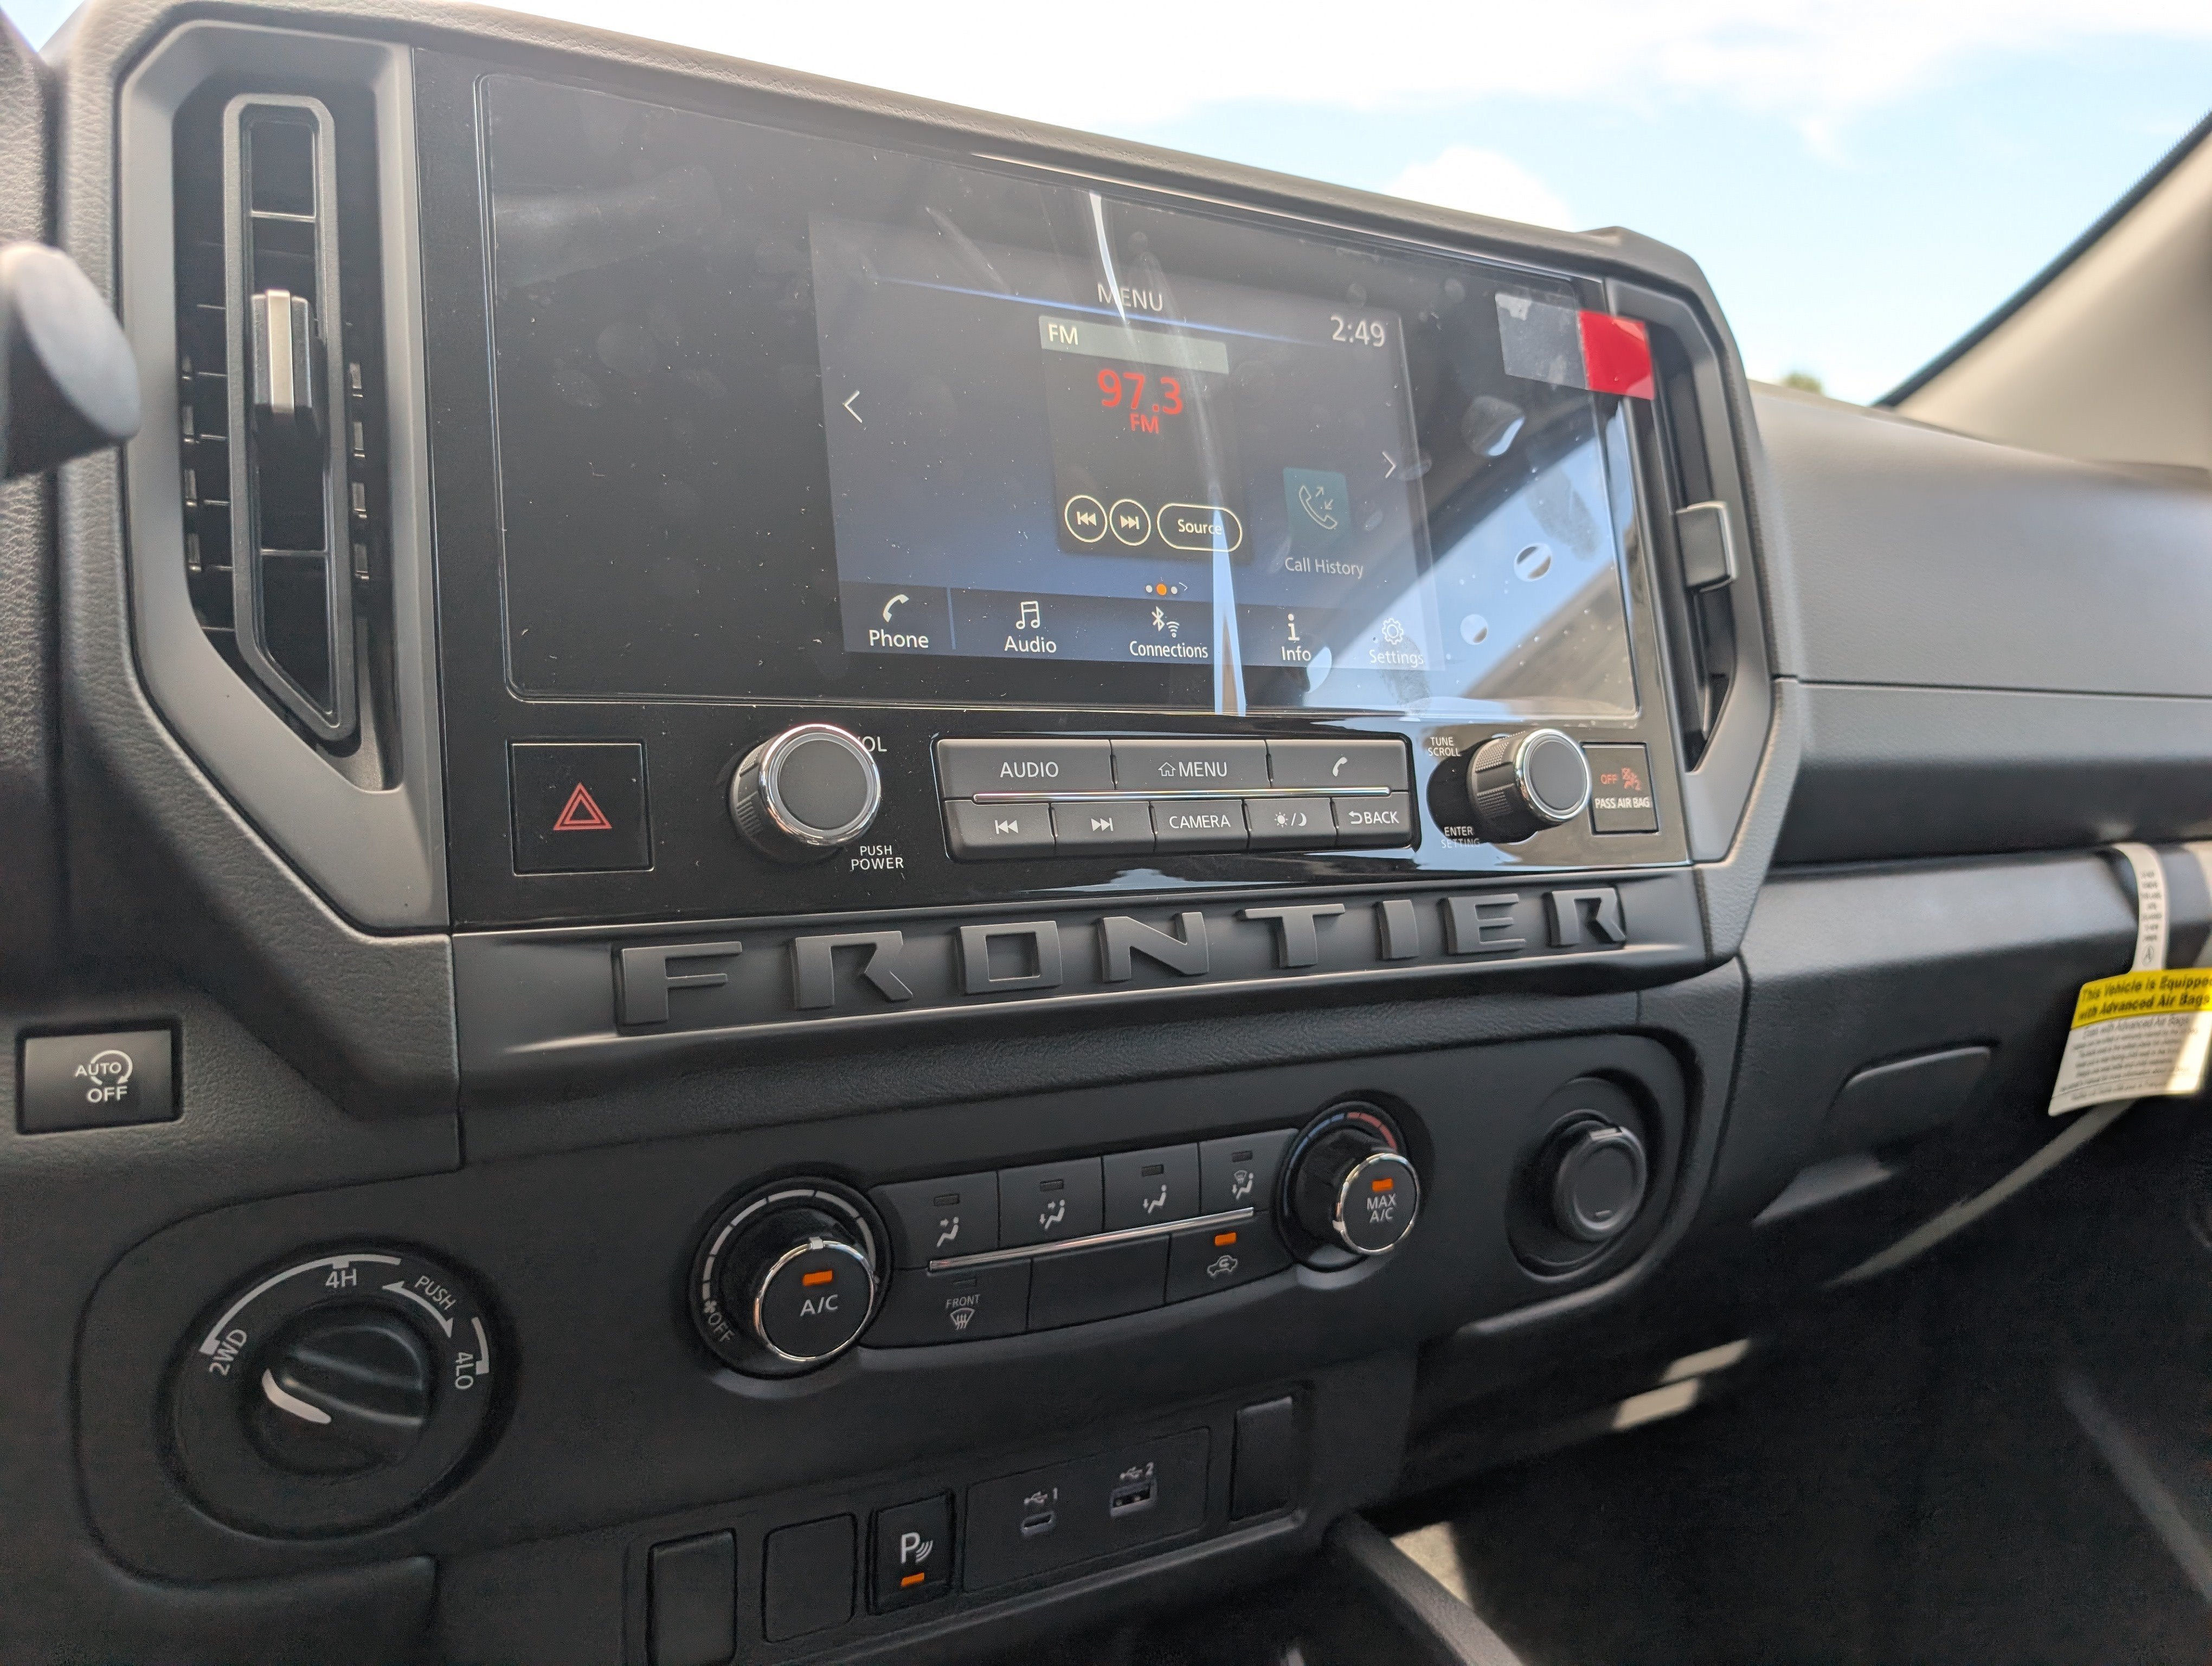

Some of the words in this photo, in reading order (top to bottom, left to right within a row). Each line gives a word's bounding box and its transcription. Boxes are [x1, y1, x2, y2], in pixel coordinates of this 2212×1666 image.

[1097, 283, 1163, 312] MENU
[1048, 324, 1078, 345] FM
[1330, 316, 1387, 348] 2:49
[1097, 369, 1184, 415] 97.3
[1130, 413, 1160, 434] FM
[1178, 518, 1223, 536] Source
[1285, 556, 1311, 573] Call
[1314, 559, 1364, 579] History
[869, 629, 929, 649] Phone
[1004, 635, 1057, 653] Audio
[1129, 640, 1208, 659] Connections
[1282, 645, 1311, 662] Info
[1368, 649, 1424, 667] Settings
[858, 736, 888, 752] OL
[1430, 736, 1454, 747] TUNE
[1427, 747, 1461, 757] SCROLL
[999, 761, 1059, 778] AUDIO
[1179, 761, 1227, 777] MENU
[1600, 773, 1617, 785] OFF
[1594, 798, 1616, 809] PASS
[1617, 797, 1633, 808] AIR
[1633, 796, 1651, 808] BAG
[1169, 814, 1231, 829] CAMERA
[1364, 811, 1400, 825] BACK
[1444, 826, 1474, 837] ENTER
[859, 845, 893, 856] PUSH
[1441, 838, 1480, 849] SETTING
[851, 857, 904, 870] POWER
[618, 887, 1627, 1027] FRONTIER
[2082, 987, 2101, 1002] This
[2105, 979, 2142, 996] Vehicle
[2100, 996, 2155, 1015] Advanced
[2157, 994, 2176, 1007] Air
[2179, 992, 2210, 1007] Bags
[74, 1061, 122, 1078] AUTO
[87, 1085, 128, 1104] OFF
[1366, 1193, 1397, 1210] MAX
[1369, 1206, 1394, 1223] A/C
[325, 1268, 358, 1289] 4H
[414, 1276, 456, 1311] PUSH
[945, 1293, 981, 1308] FRONT
[799, 1293, 839, 1317] A/C
[708, 1312, 735, 1342] OFF
[209, 1328, 248, 1376] 2WD
[454, 1350, 474, 1391] 4LO
[1146, 1462, 1154, 1478] 2
[1052, 1488, 1058, 1501] 1
[900, 1532, 921, 1564] P
